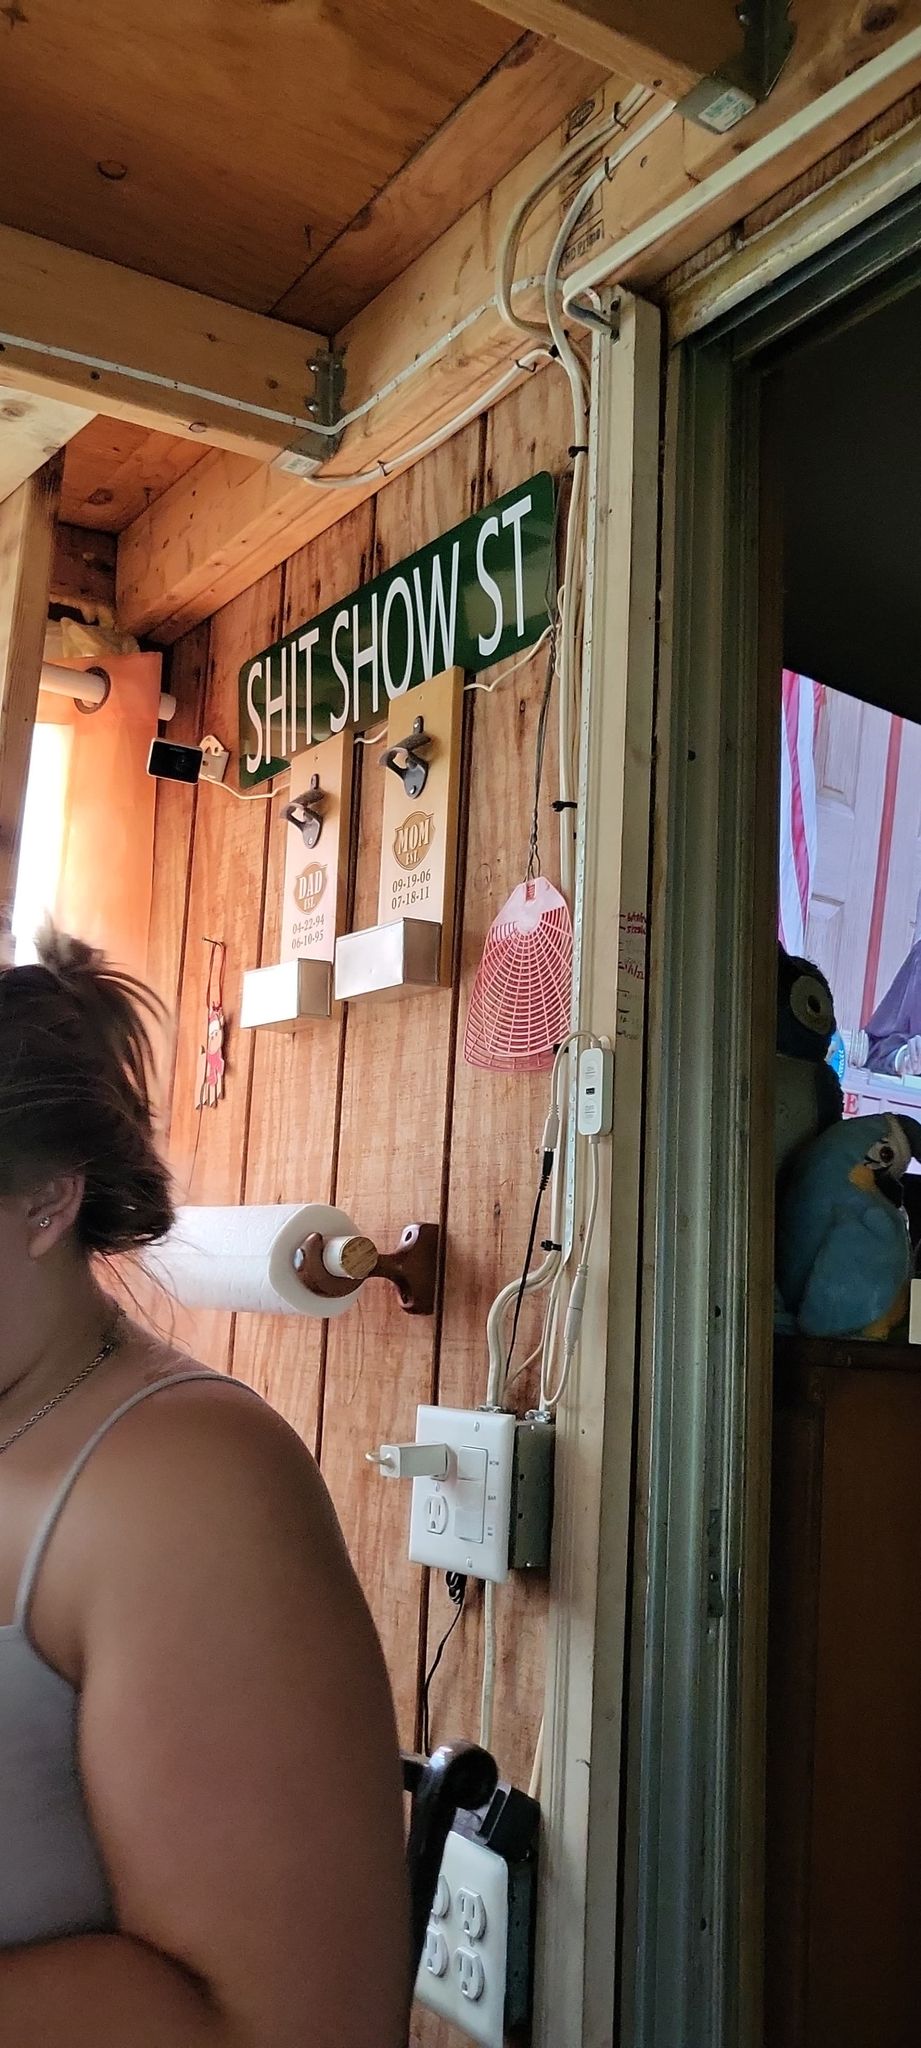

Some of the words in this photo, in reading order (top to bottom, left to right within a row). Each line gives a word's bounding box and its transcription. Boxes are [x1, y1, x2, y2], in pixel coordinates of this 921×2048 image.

[246, 627, 320, 774] SHIT
[329, 541, 460, 734] SHOW
[476, 494, 532, 657] ST
[397, 818, 430, 855] MOM
[299, 870, 323, 900] DAD
